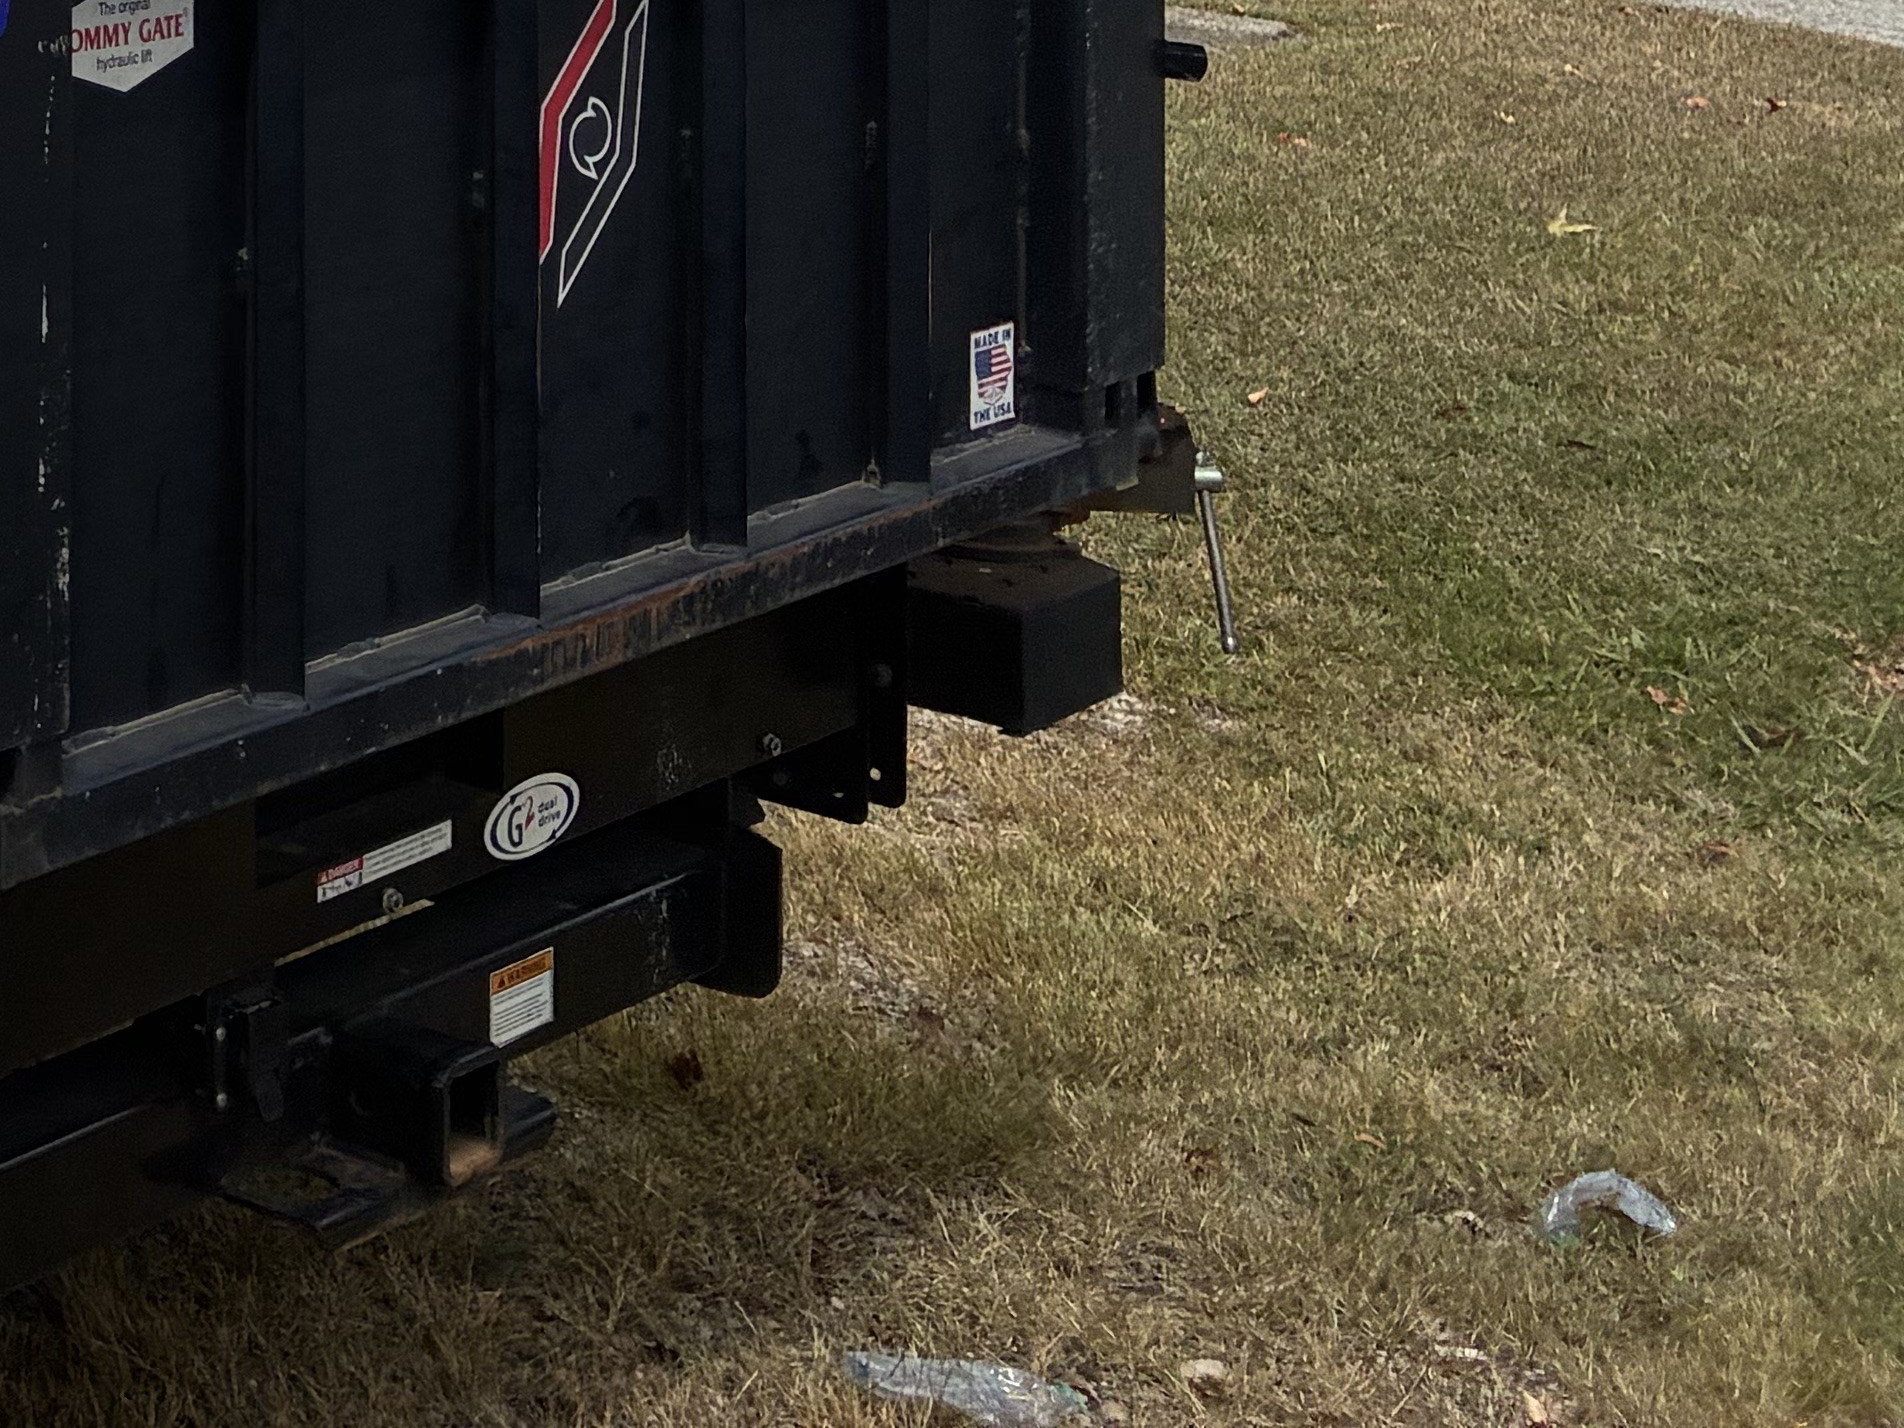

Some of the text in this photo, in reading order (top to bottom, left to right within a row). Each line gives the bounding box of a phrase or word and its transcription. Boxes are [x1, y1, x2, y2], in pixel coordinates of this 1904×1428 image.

[98, 1, 116, 16] The
[68, 21, 132, 54] OMMY
[96, 50, 139, 73] hydraulic
[974, 327, 1012, 350] MADE IN
[973, 401, 1012, 424] THE USA
